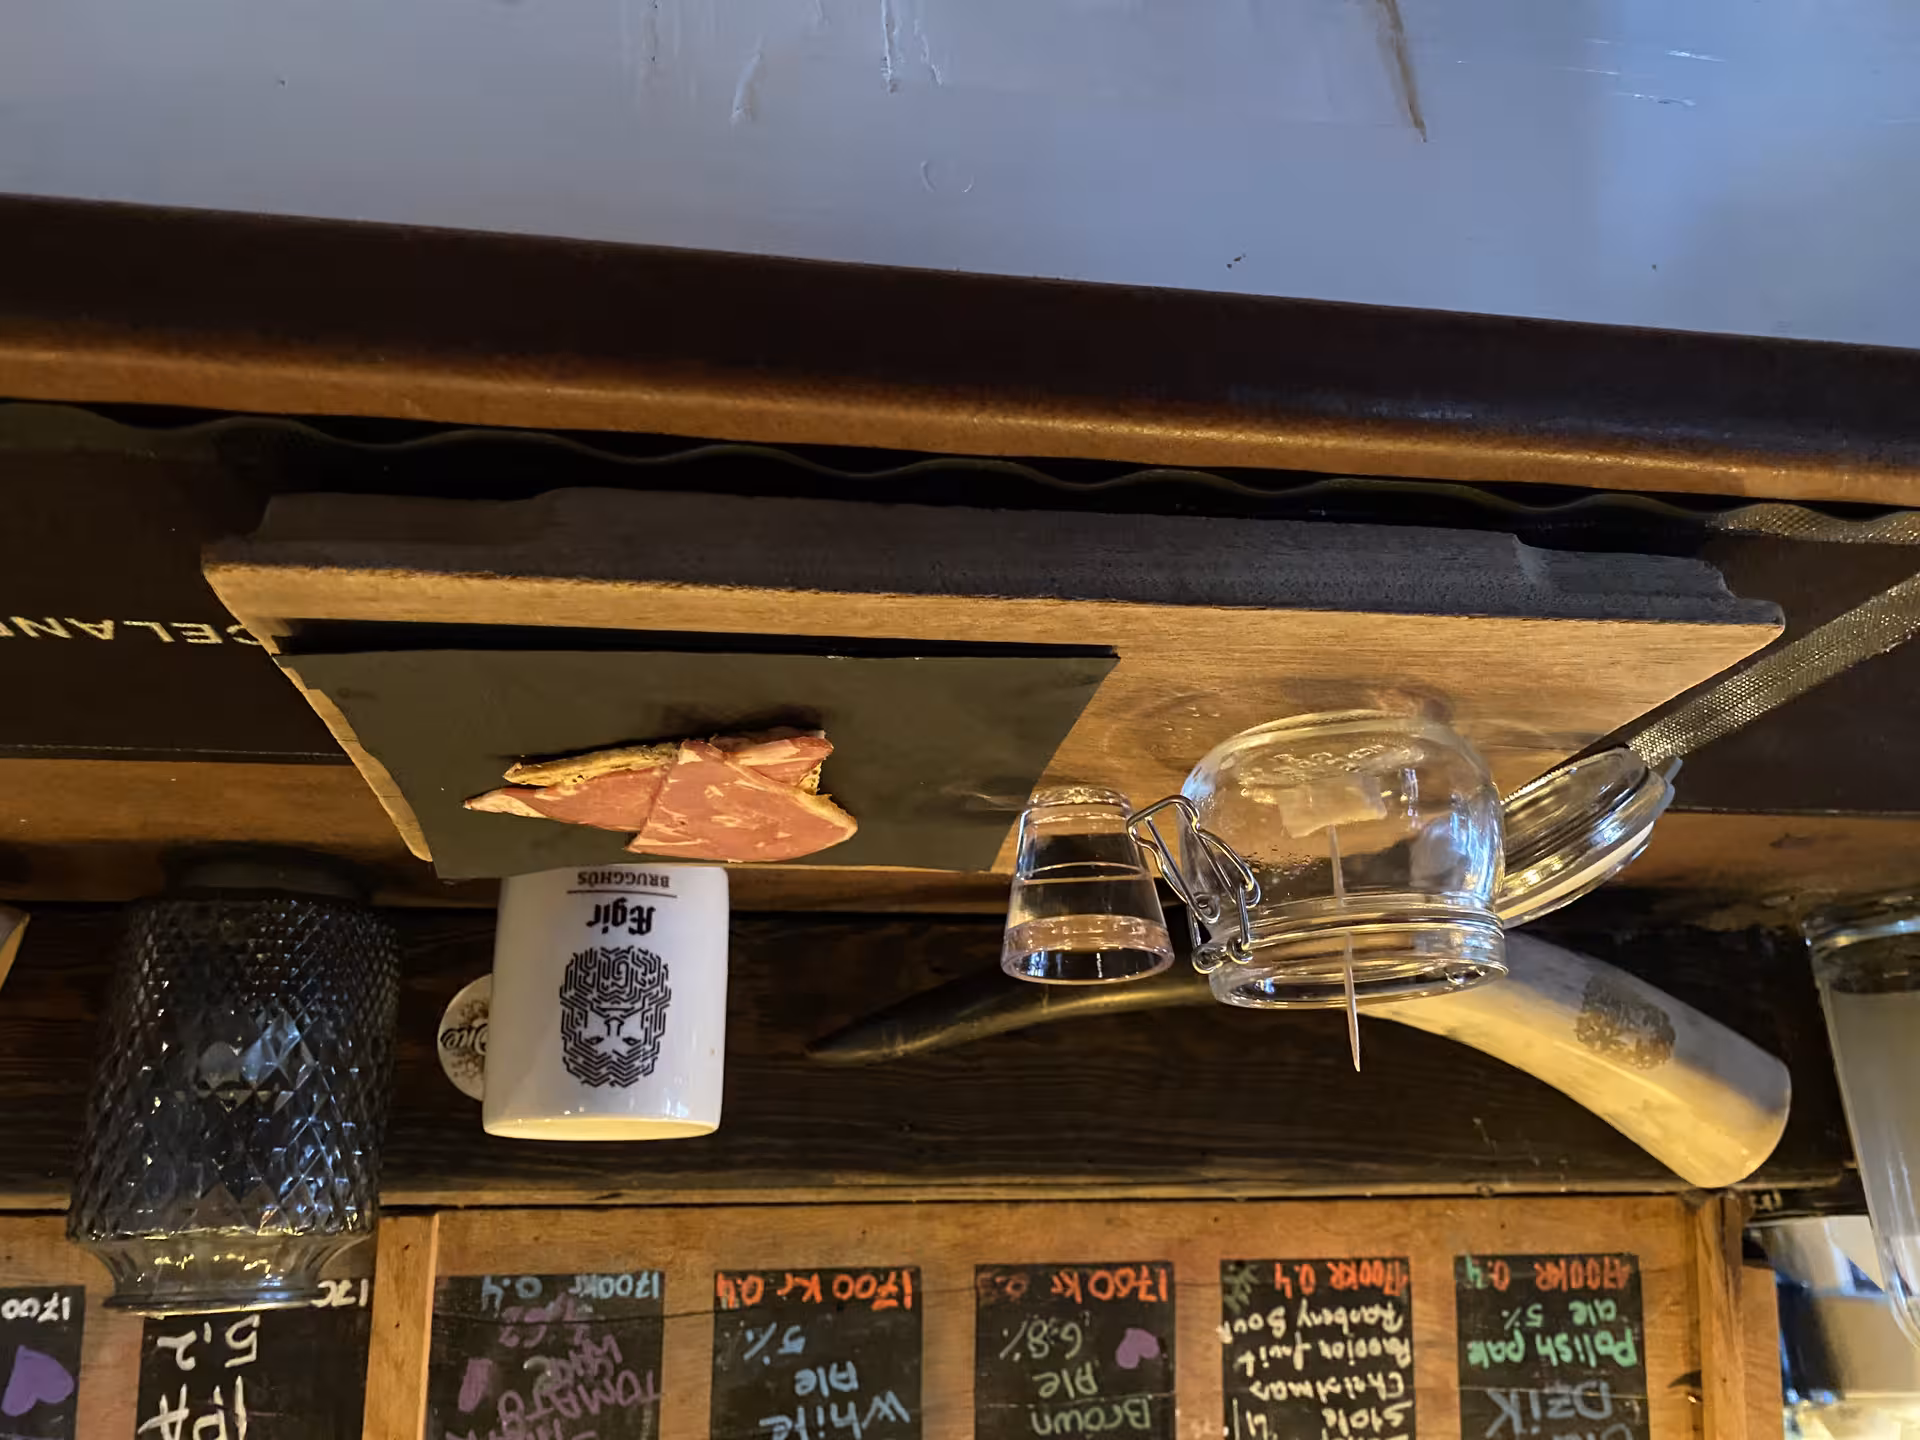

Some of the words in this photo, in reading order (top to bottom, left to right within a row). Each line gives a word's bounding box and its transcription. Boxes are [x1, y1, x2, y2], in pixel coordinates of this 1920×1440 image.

[585, 897, 656, 936] Ægir
[481, 1276, 544, 1318] 0.4
[715, 1271, 765, 1310] 0.4
[831, 1269, 913, 1310] 1700
[1274, 1263, 1316, 1299] 0.4
[0, 1291, 71, 1323] 1700
[1501, 1303, 1544, 1330] 5%
[1568, 1298, 1617, 1326] ale
[742, 1321, 806, 1366] 5%
[1232, 1331, 1312, 1377] fruit
[1534, 1328, 1637, 1369] Polish
[794, 1360, 859, 1398] Ale
[1031, 1362, 1098, 1399] Ale
[136, 1375, 248, 1440] IPA
[759, 1390, 911, 1440] White
[1031, 1398, 1151, 1435] Brown
